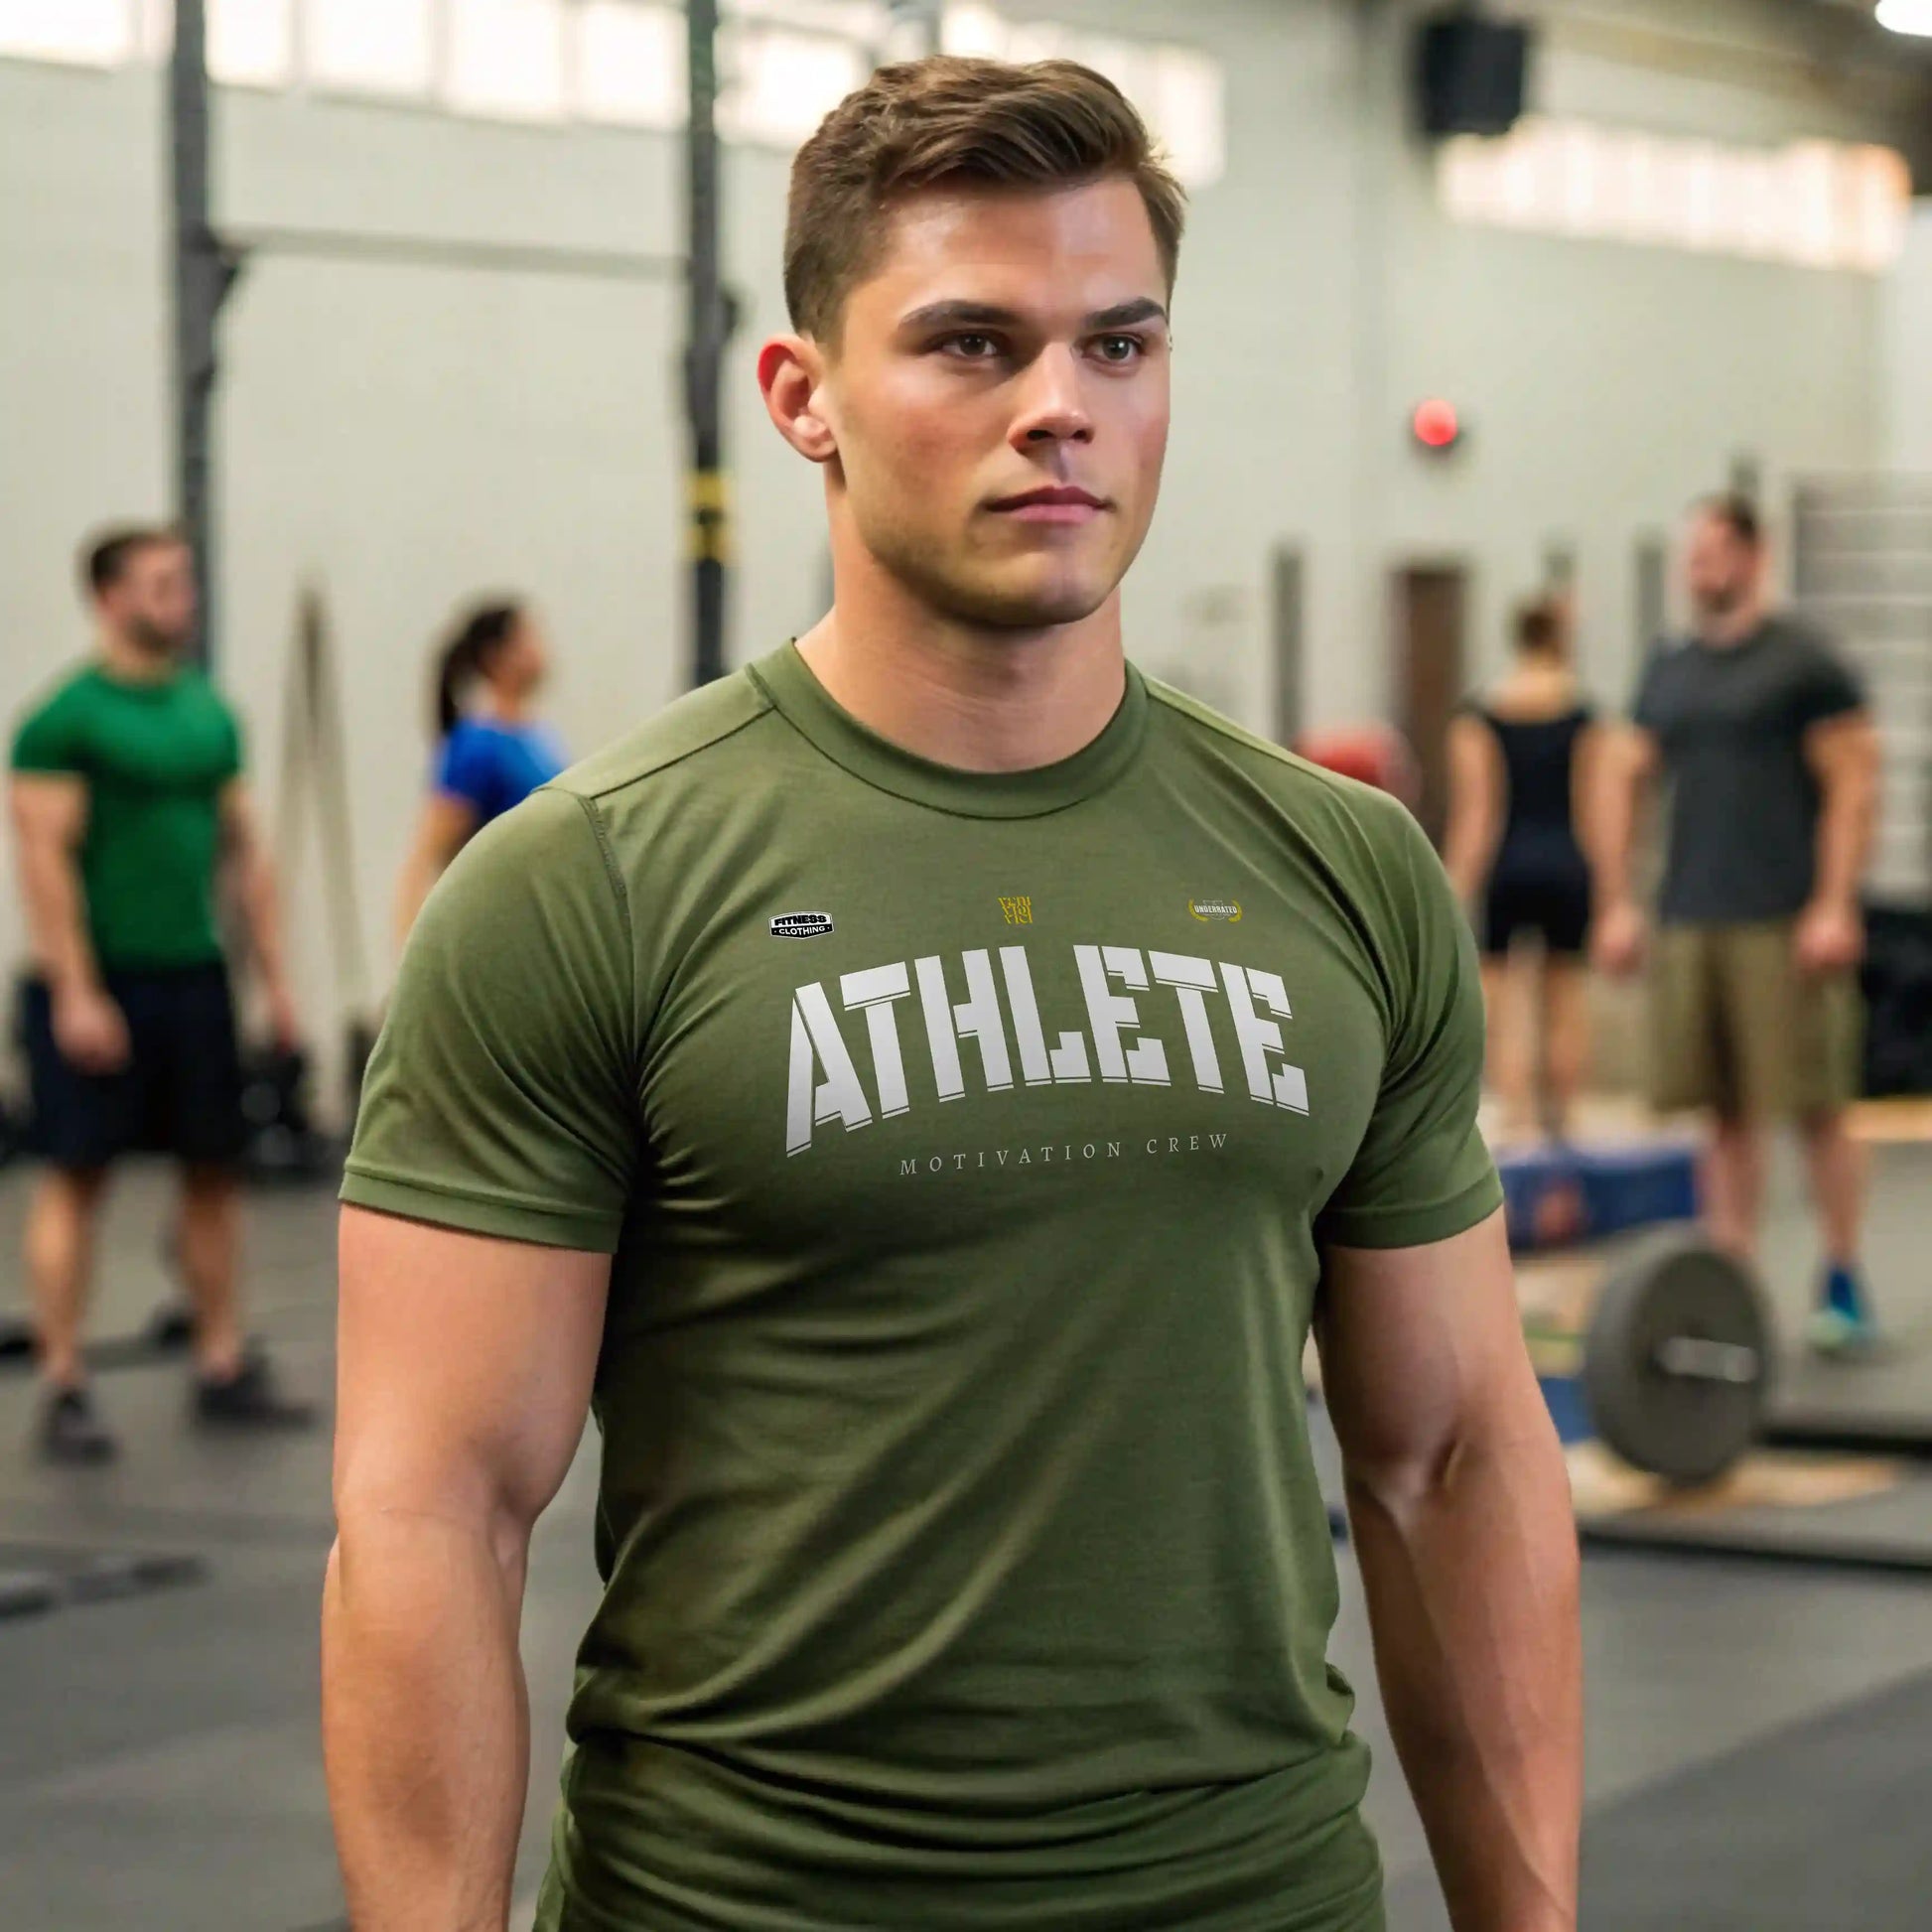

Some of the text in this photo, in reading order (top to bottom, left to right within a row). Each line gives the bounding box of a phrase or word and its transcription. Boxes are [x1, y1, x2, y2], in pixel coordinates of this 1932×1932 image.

[1193, 904, 1238, 913] UNDERRATED
[774, 914, 827, 926] FITNESS
[778, 926, 826, 935] CLOTHING
[785, 944, 1310, 1158] ATHLETE
[899, 1133, 1228, 1175] MOTIVATION CREW
